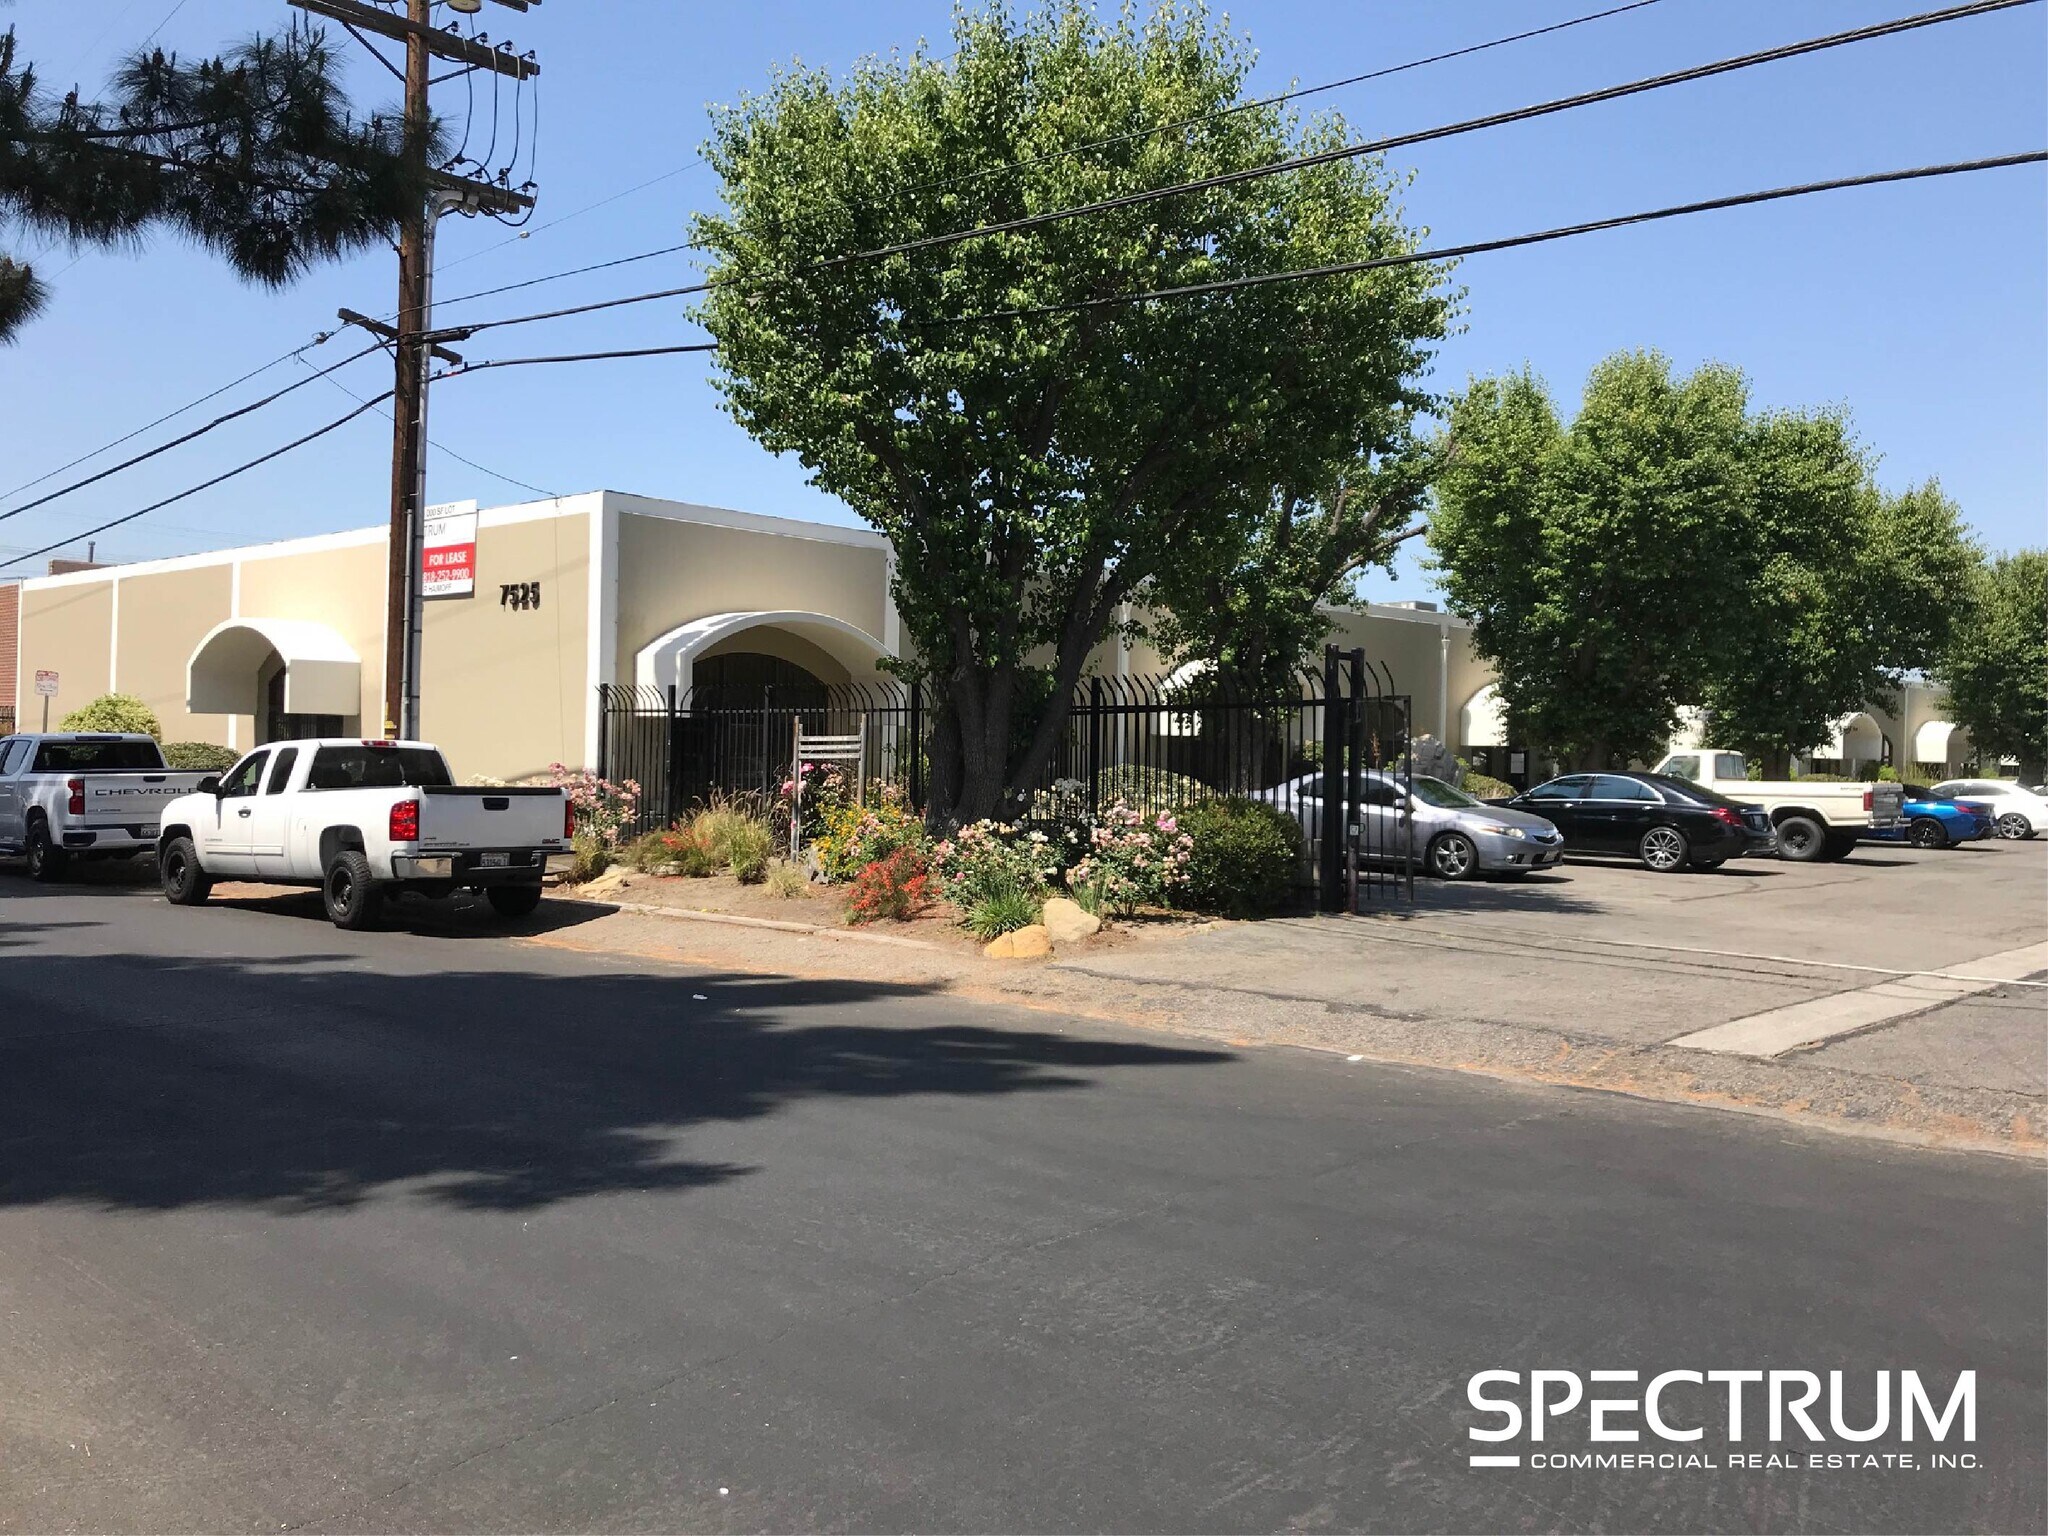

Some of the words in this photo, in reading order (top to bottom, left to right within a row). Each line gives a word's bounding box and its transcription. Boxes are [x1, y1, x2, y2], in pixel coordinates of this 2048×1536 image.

[445, 505, 456, 514] LOT
[429, 554, 444, 566] FOR
[445, 551, 467, 564] LEASE
[500, 582, 541, 611] 7525
[95, 787, 199, 796] CHEVROLE
